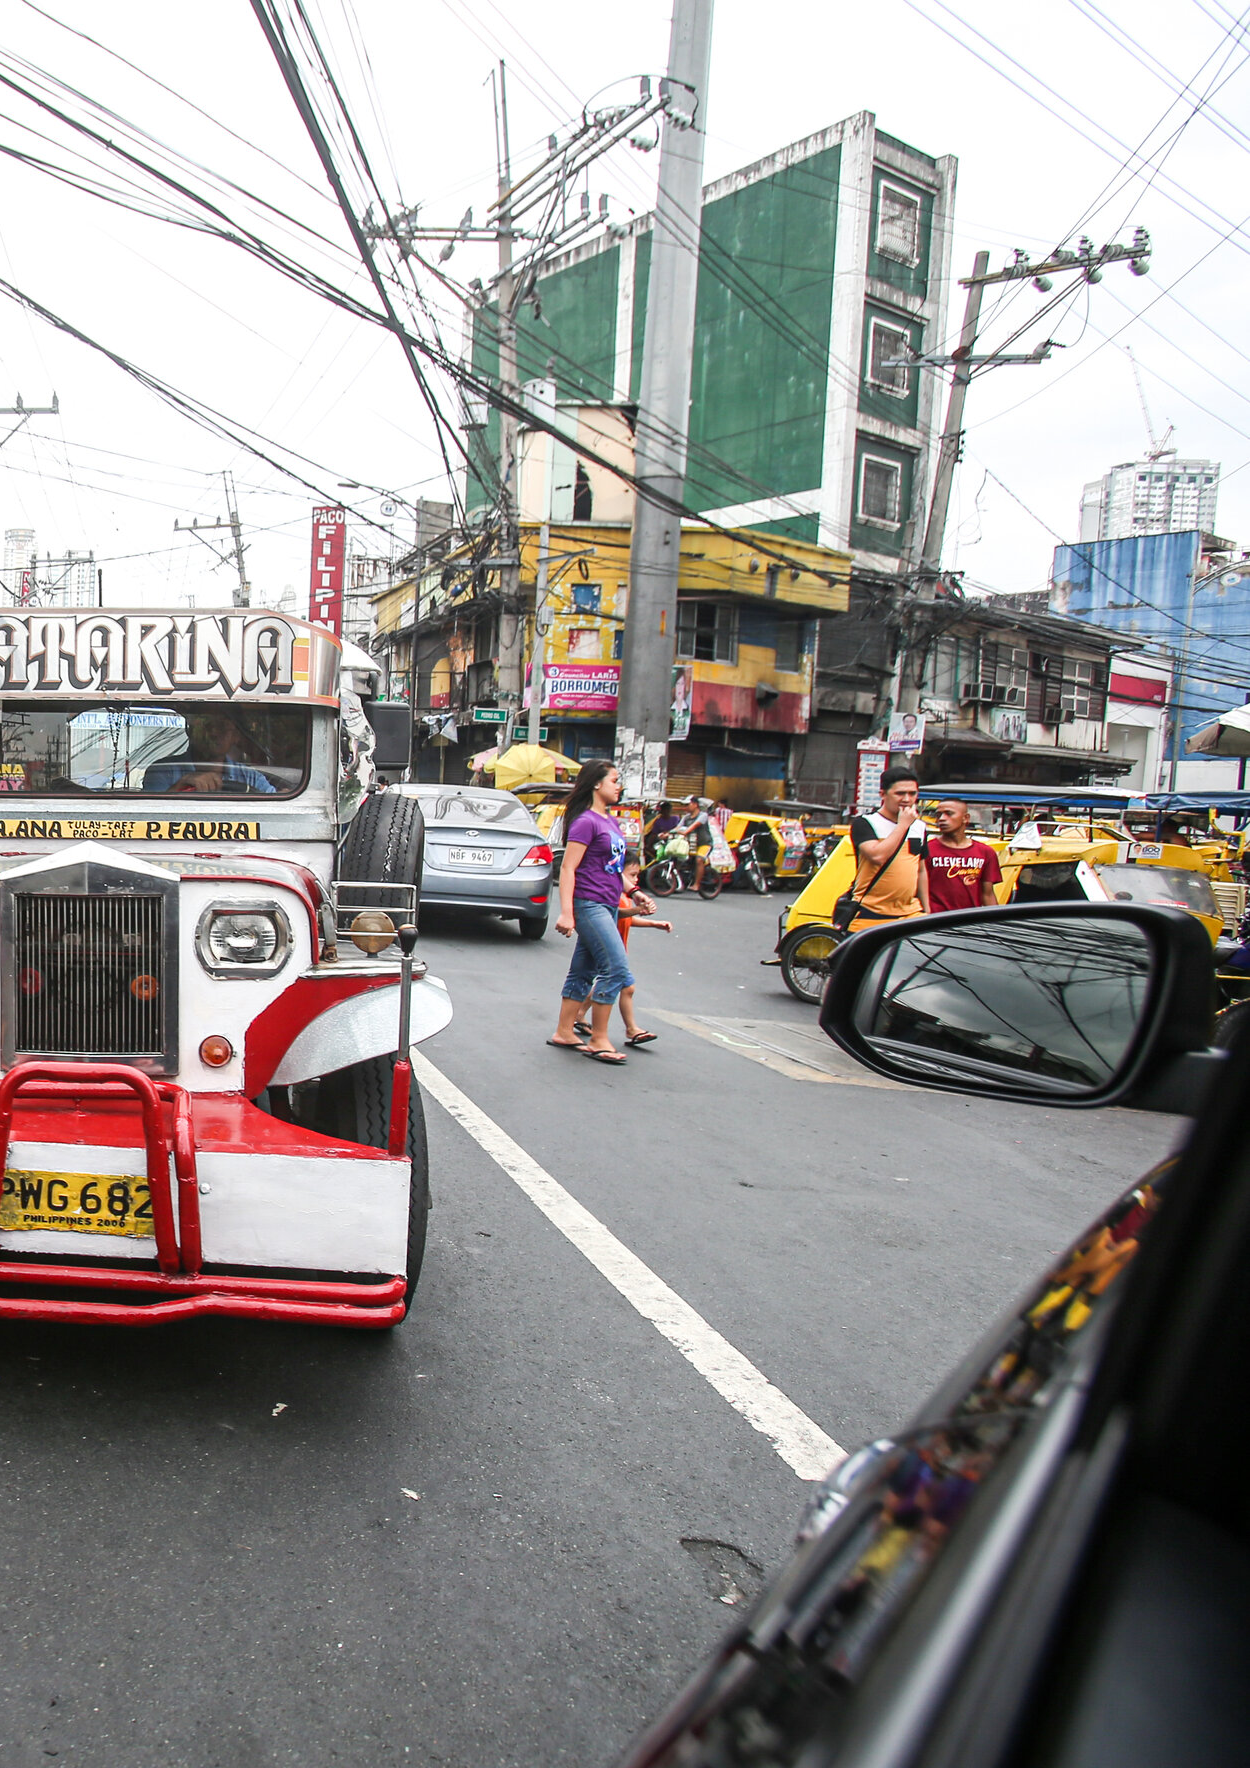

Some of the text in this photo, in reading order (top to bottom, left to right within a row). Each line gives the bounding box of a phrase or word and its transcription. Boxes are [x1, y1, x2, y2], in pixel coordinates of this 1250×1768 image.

[313, 508, 345, 524] PACO
[551, 680, 618, 695] BORROMEO
[471, 852, 493, 863] 9467
[79, 1181, 154, 1219] 682
[23, 1214, 92, 1226] PHILIPPINES
